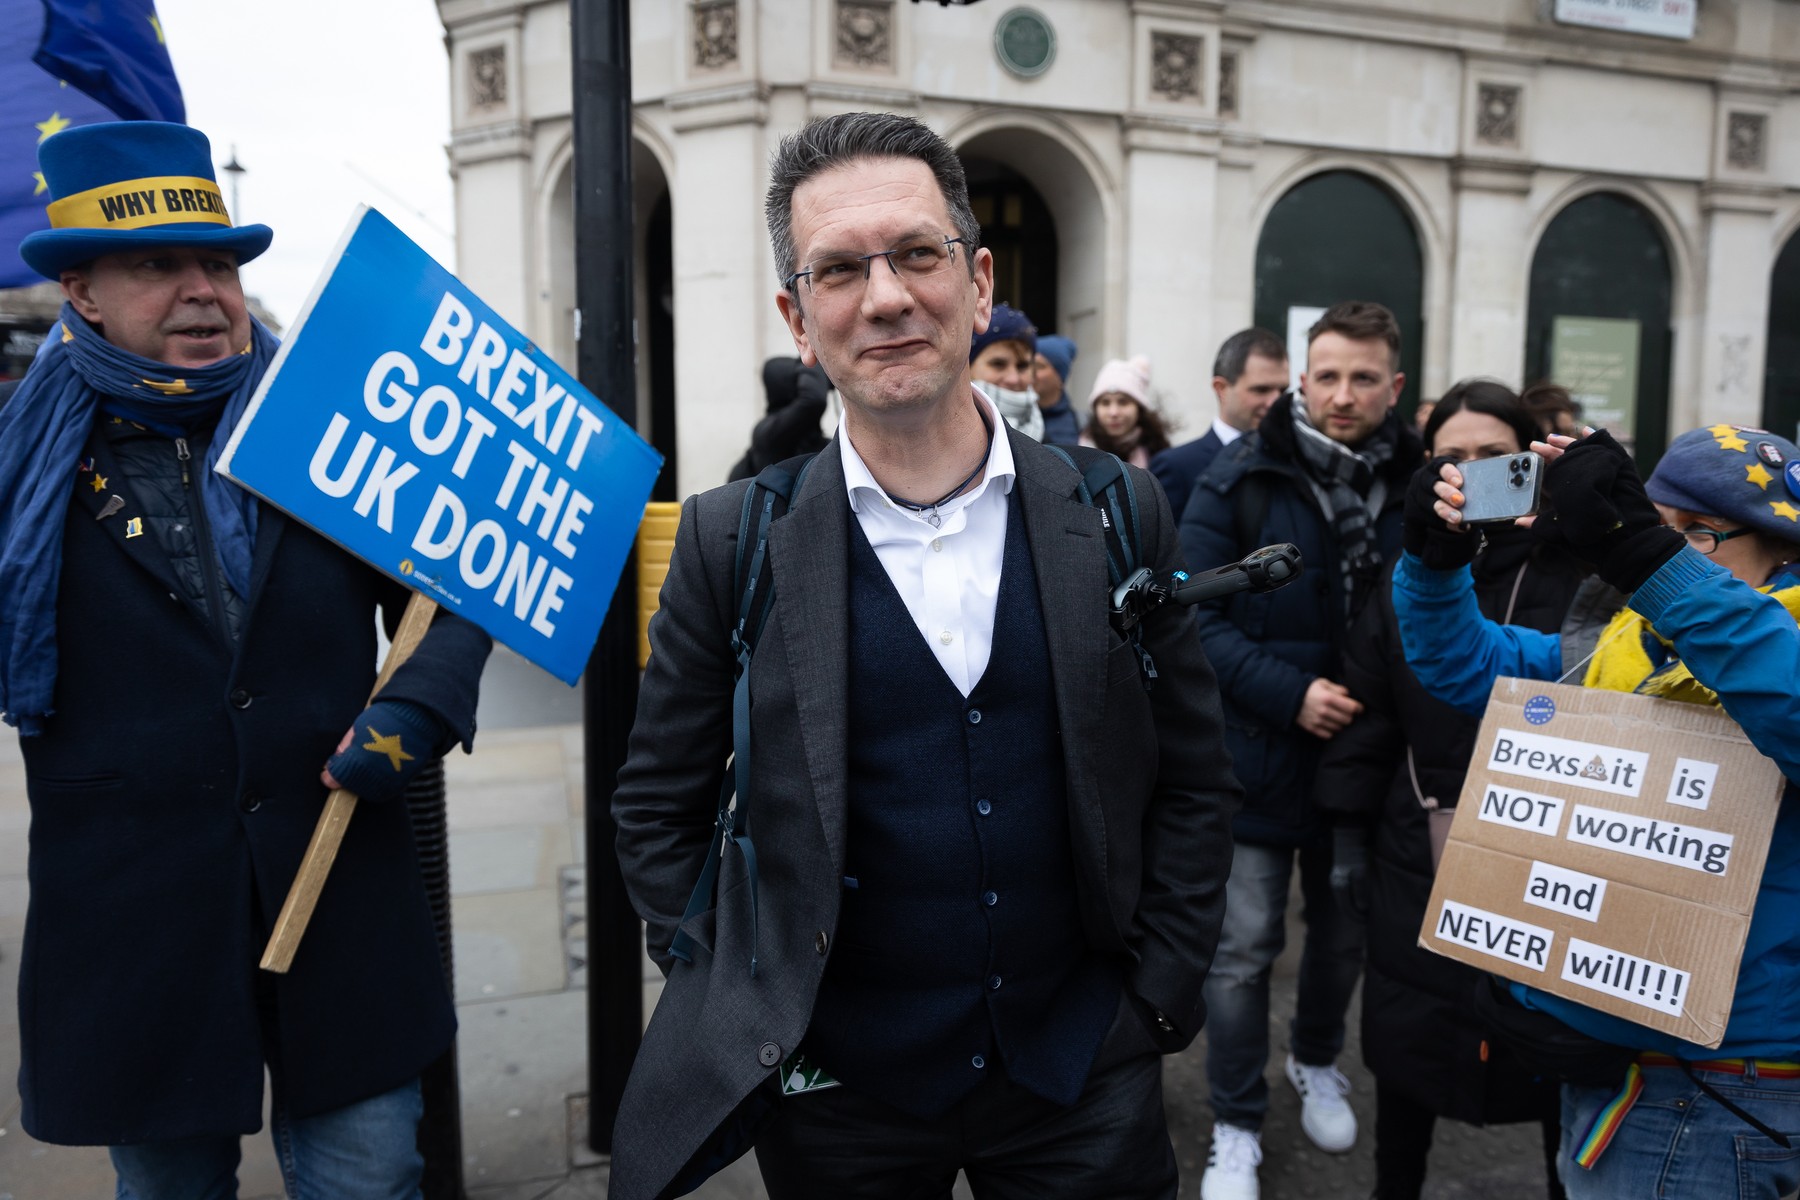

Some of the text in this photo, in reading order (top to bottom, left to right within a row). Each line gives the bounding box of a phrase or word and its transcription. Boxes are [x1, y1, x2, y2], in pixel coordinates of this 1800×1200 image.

[98, 189, 157, 222] WHY
[421, 292, 603, 470] BREXIT
[364, 352, 593, 558] GOT THE
[310, 413, 573, 637] UK DONE
[1675, 768, 1705, 801] is
[1483, 790, 1730, 874] NOT working
[1529, 875, 1597, 912] and
[1439, 909, 1683, 1006] NEVER will!!!
